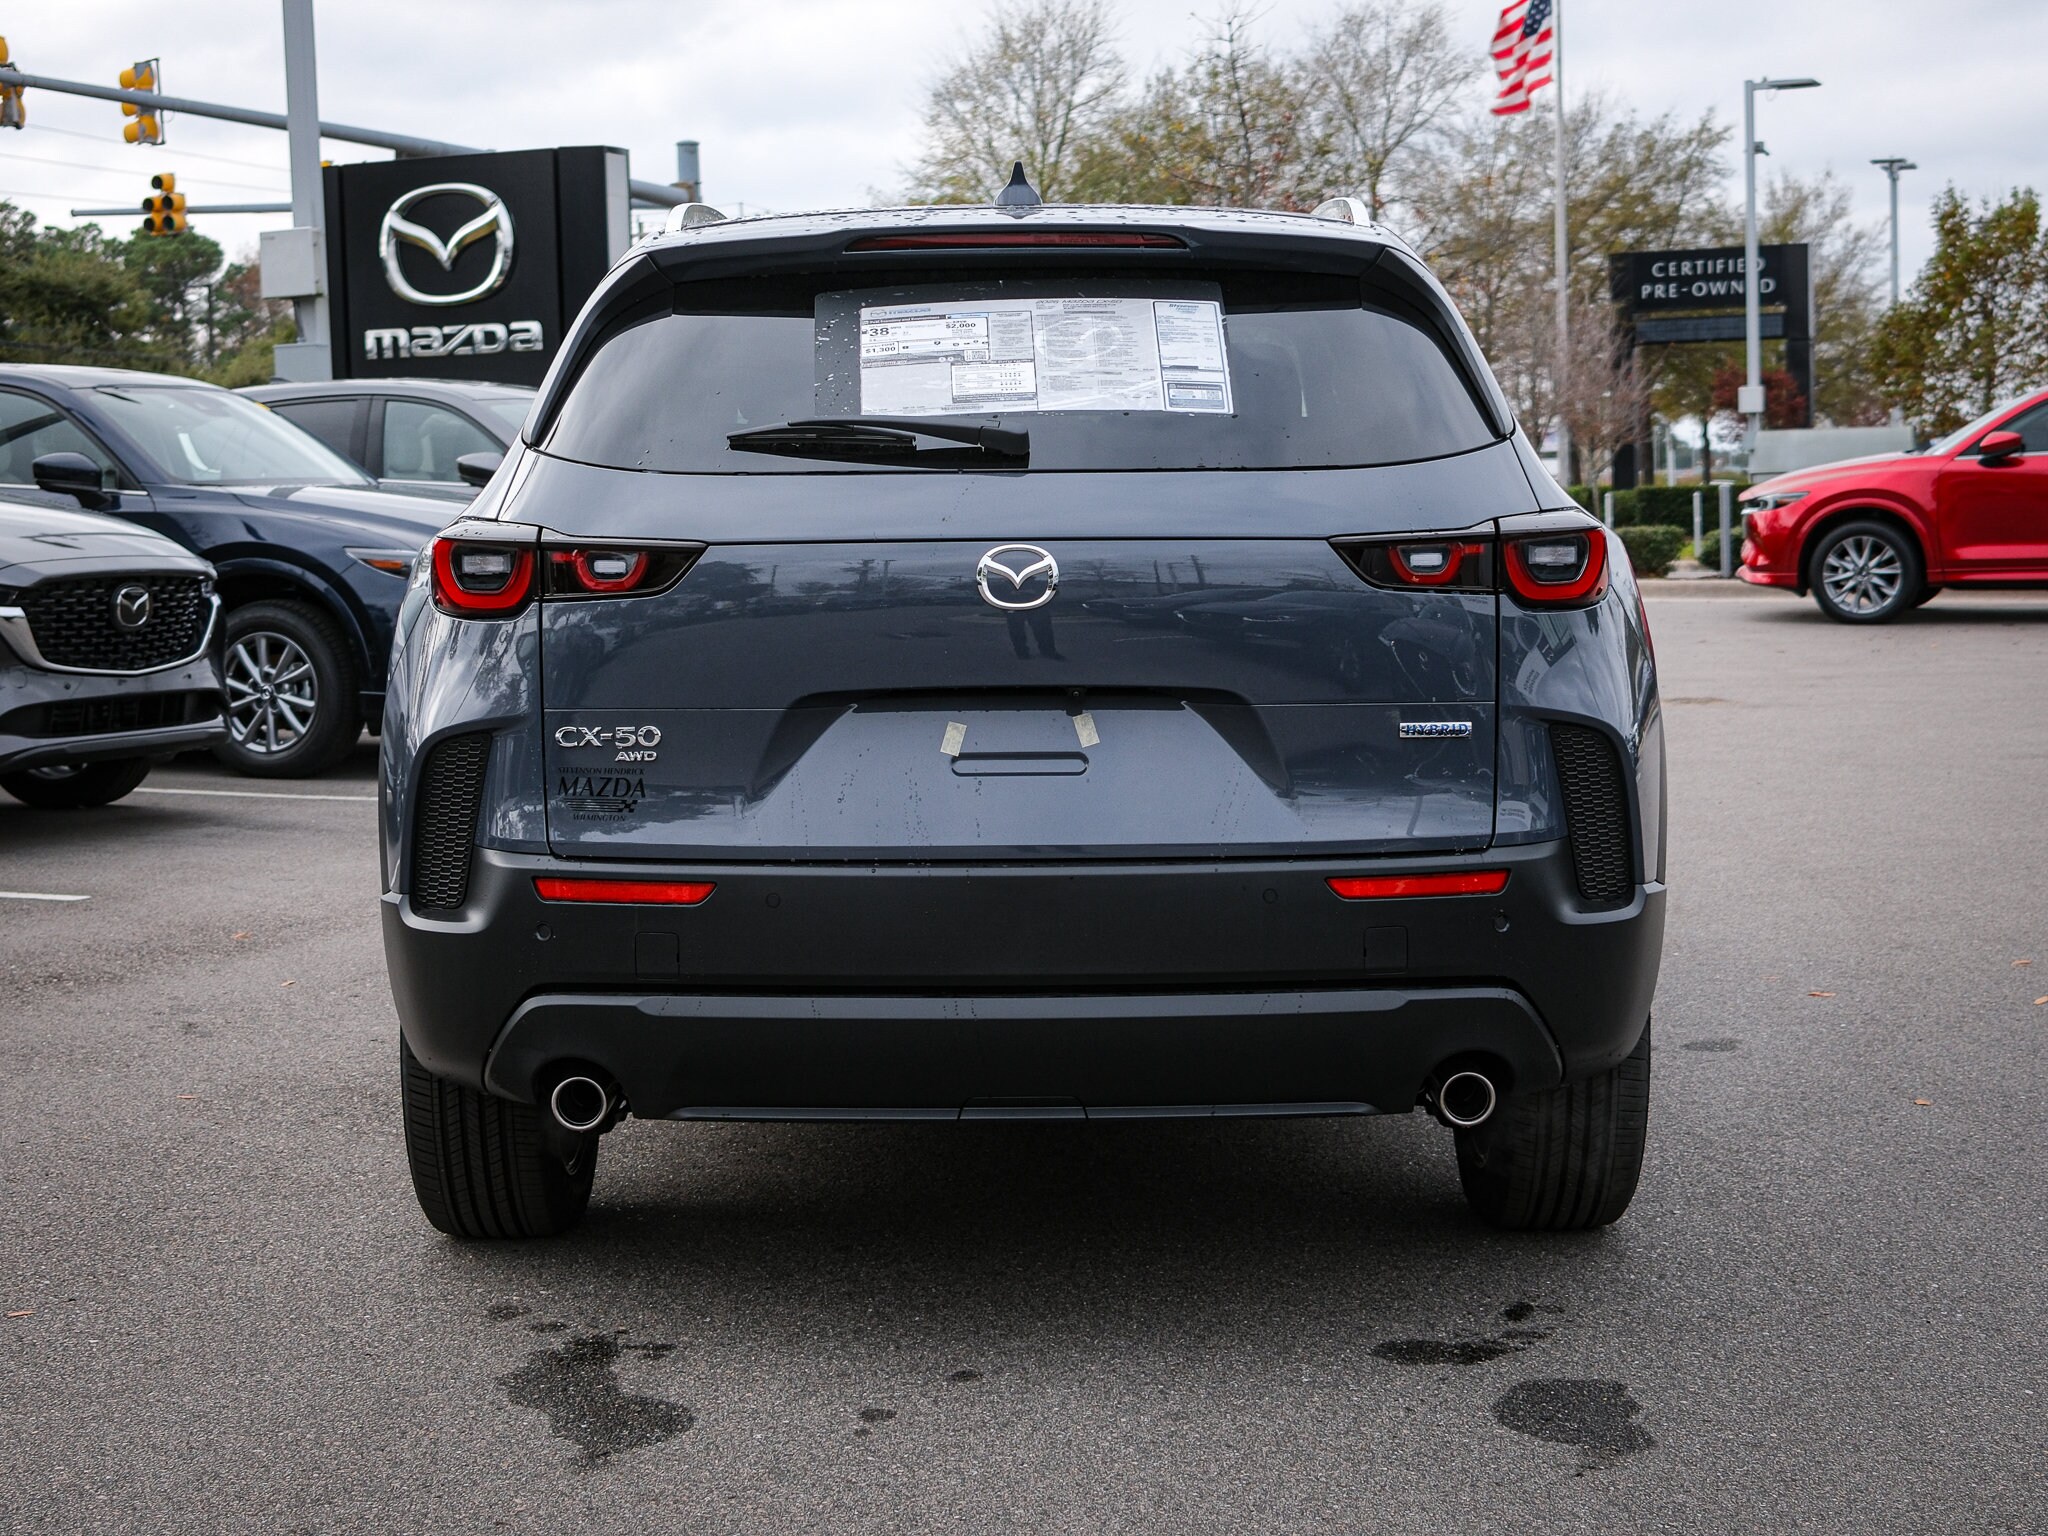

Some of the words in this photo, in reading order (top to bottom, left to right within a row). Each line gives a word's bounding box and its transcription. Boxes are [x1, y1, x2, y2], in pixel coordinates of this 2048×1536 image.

[1641, 277, 1777, 299] PRE-OWND
[869, 327, 890, 337] 38
[555, 725, 662, 748] CX-50
[1405, 723, 1470, 737] HYBRID
[614, 750, 657, 762] AWD
[558, 766, 602, 776] STEVENSON
[604, 766, 646, 776] HENDRICK
[558, 776, 647, 798] MAZDA
[573, 812, 626, 822] WILMINGTON
